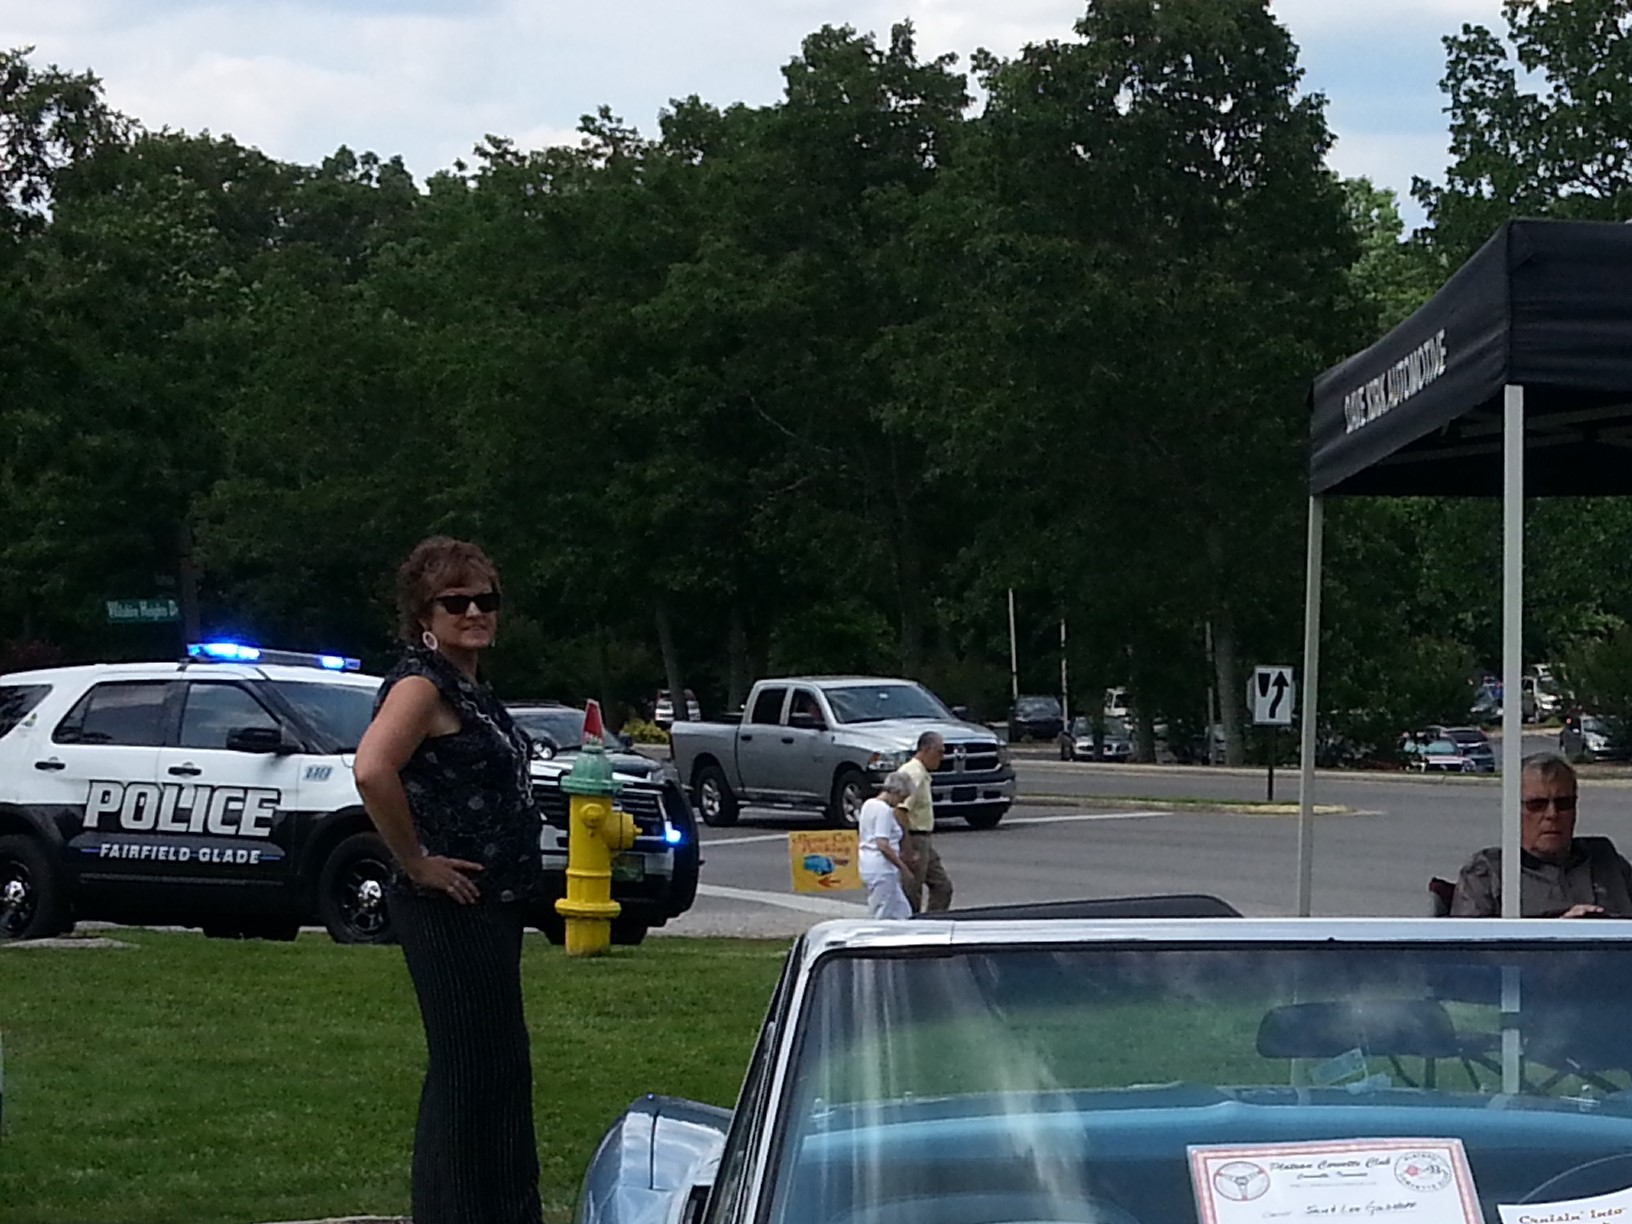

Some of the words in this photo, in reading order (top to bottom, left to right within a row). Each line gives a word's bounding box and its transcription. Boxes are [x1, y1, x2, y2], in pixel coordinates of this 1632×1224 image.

[83, 779, 282, 837] POLICE
[100, 843, 192, 861] FAIRFIELD
[198, 846, 262, 864] GLADE
